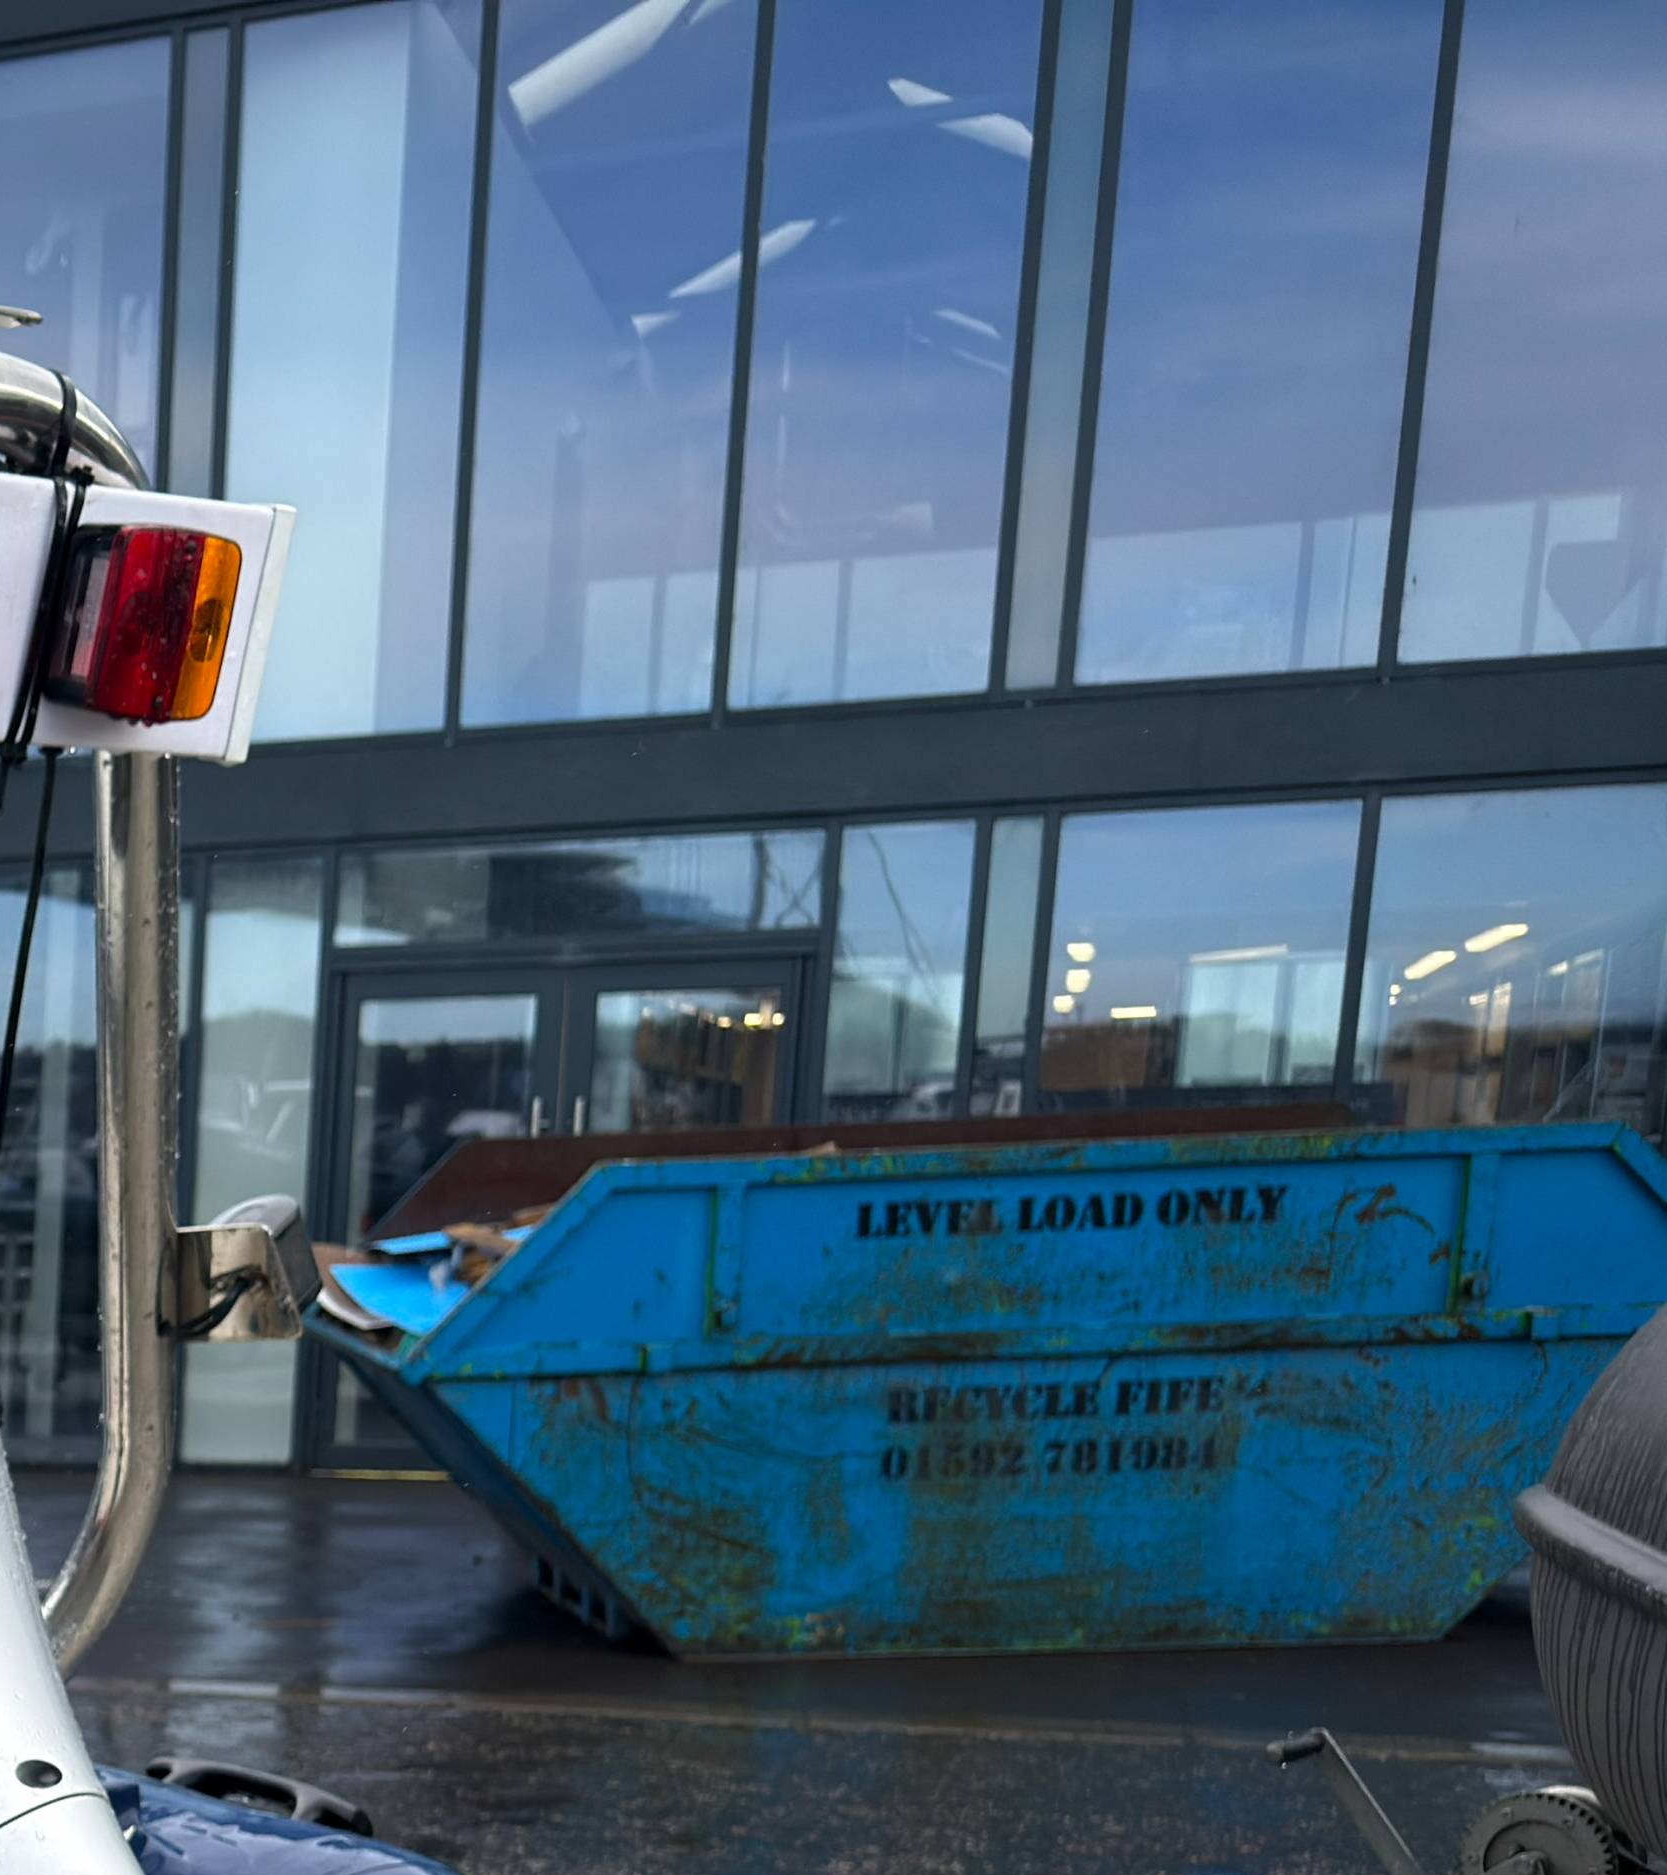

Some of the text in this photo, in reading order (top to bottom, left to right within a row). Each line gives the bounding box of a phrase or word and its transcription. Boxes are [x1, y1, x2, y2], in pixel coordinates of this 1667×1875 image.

[856, 1184, 1288, 1238] LEVEL LOAD ONLY
[886, 1374, 1225, 1424] RECYCLE FIFE
[880, 1433, 1219, 1480] 01592 781984
